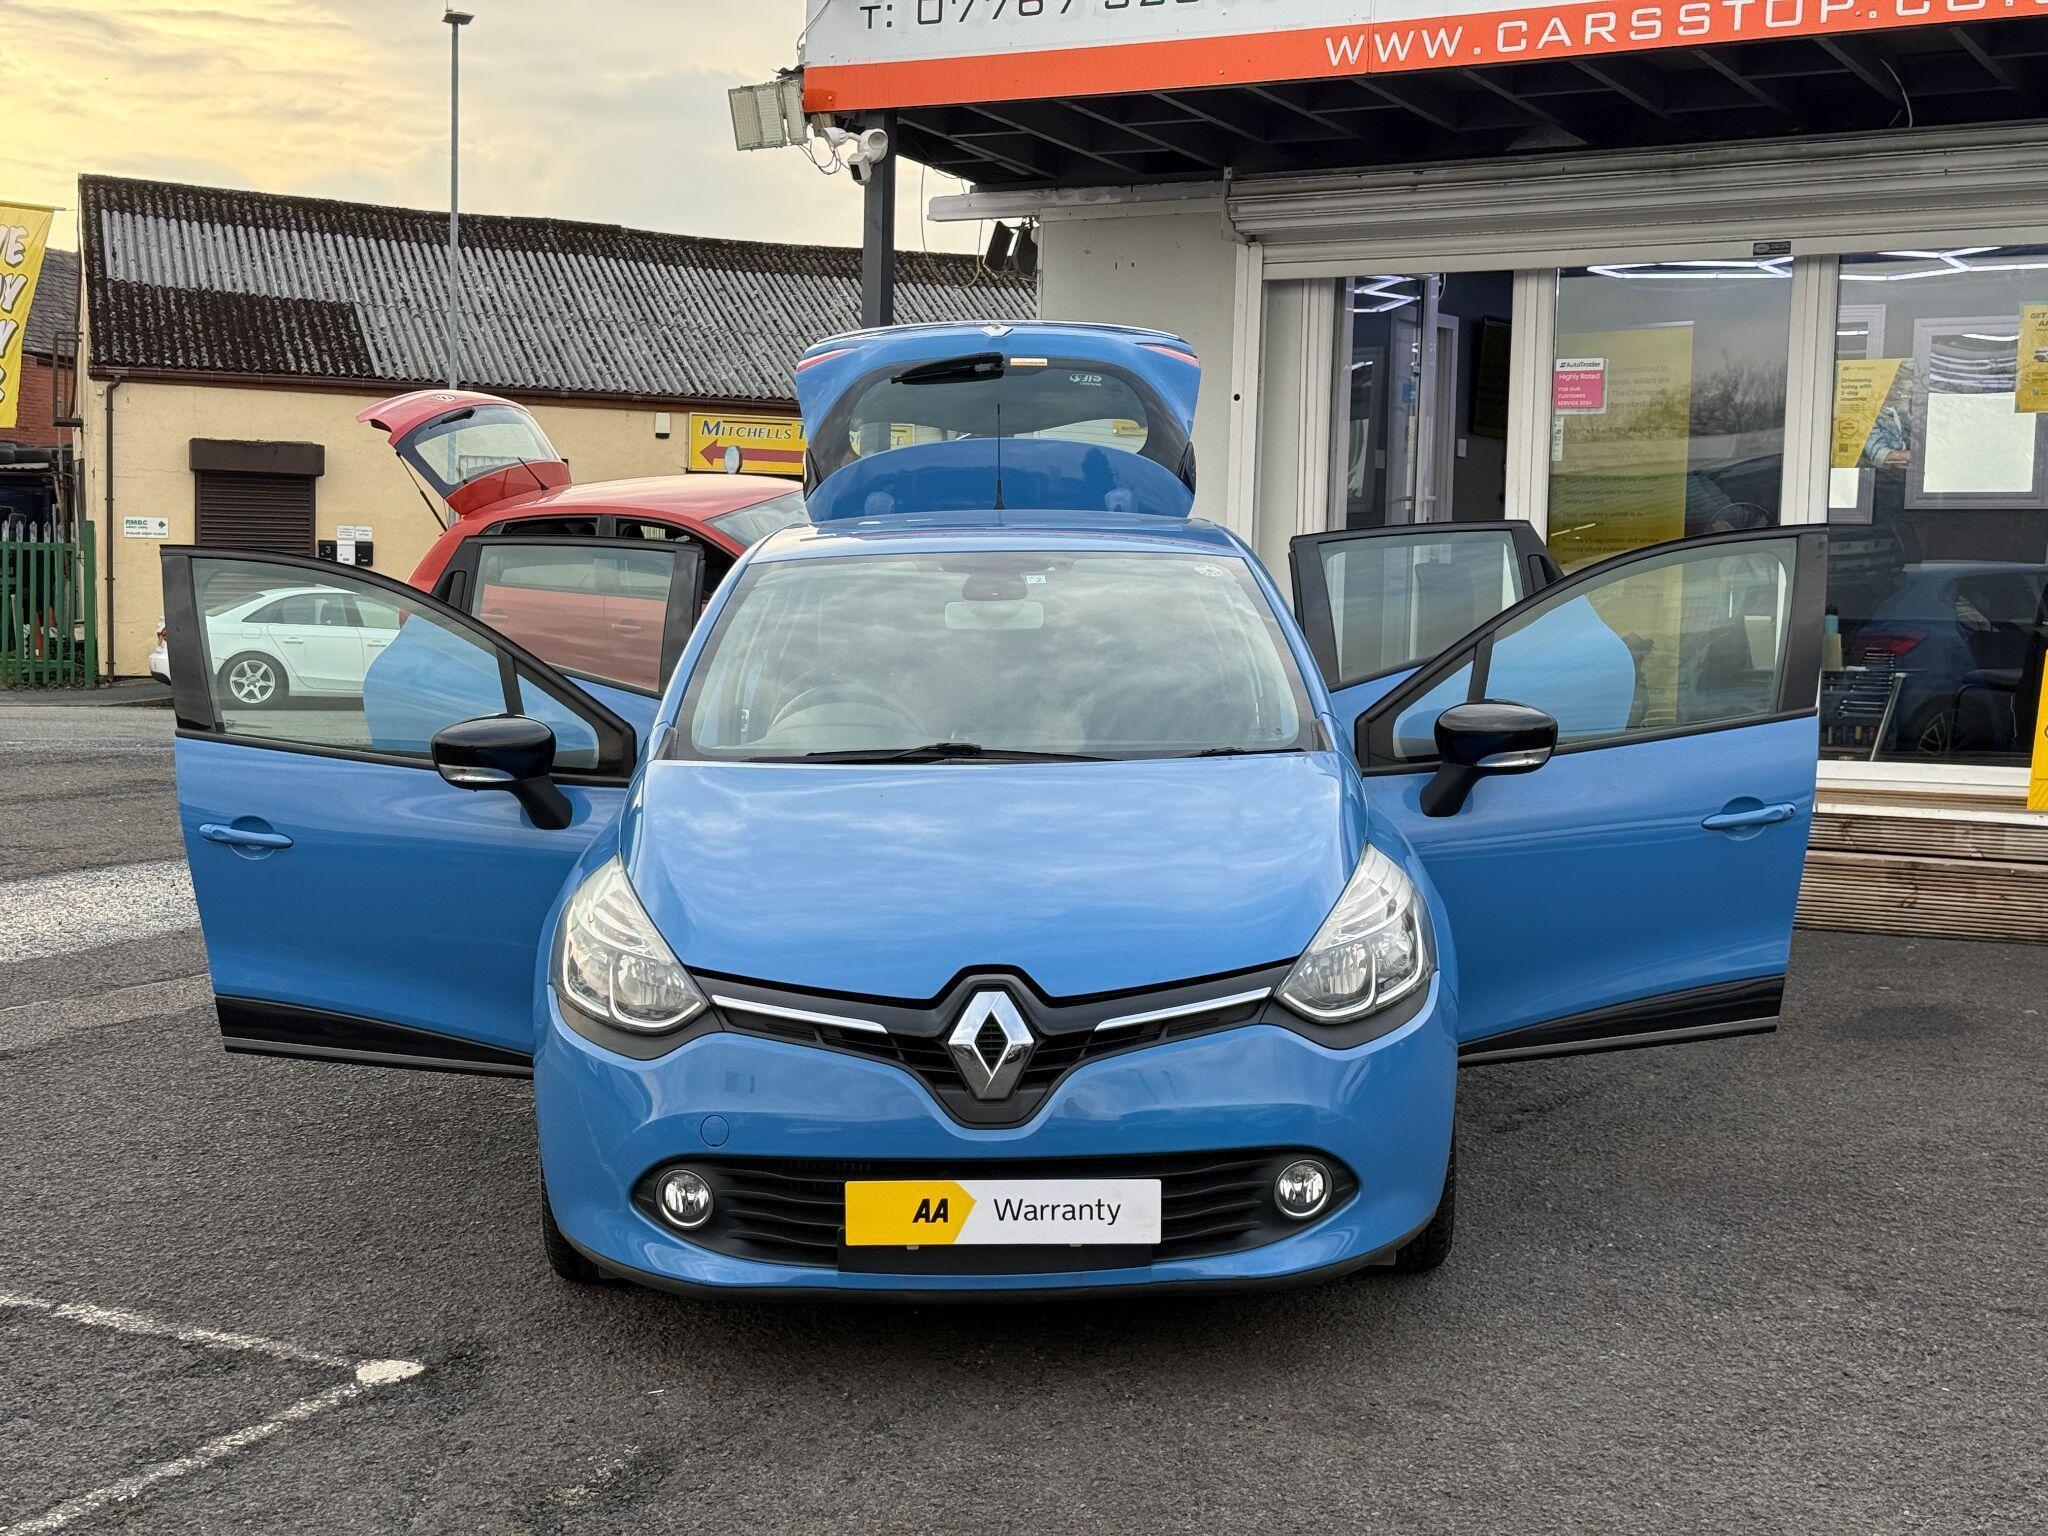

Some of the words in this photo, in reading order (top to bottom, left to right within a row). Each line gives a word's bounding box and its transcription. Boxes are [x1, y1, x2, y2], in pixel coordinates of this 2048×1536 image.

[859, 5, 893, 29] T:
[1559, 373, 1579, 381] Highly
[701, 419, 792, 440] MITCHELLS
[912, 1197, 949, 1223] AA
[993, 1197, 1122, 1226] Warranty
